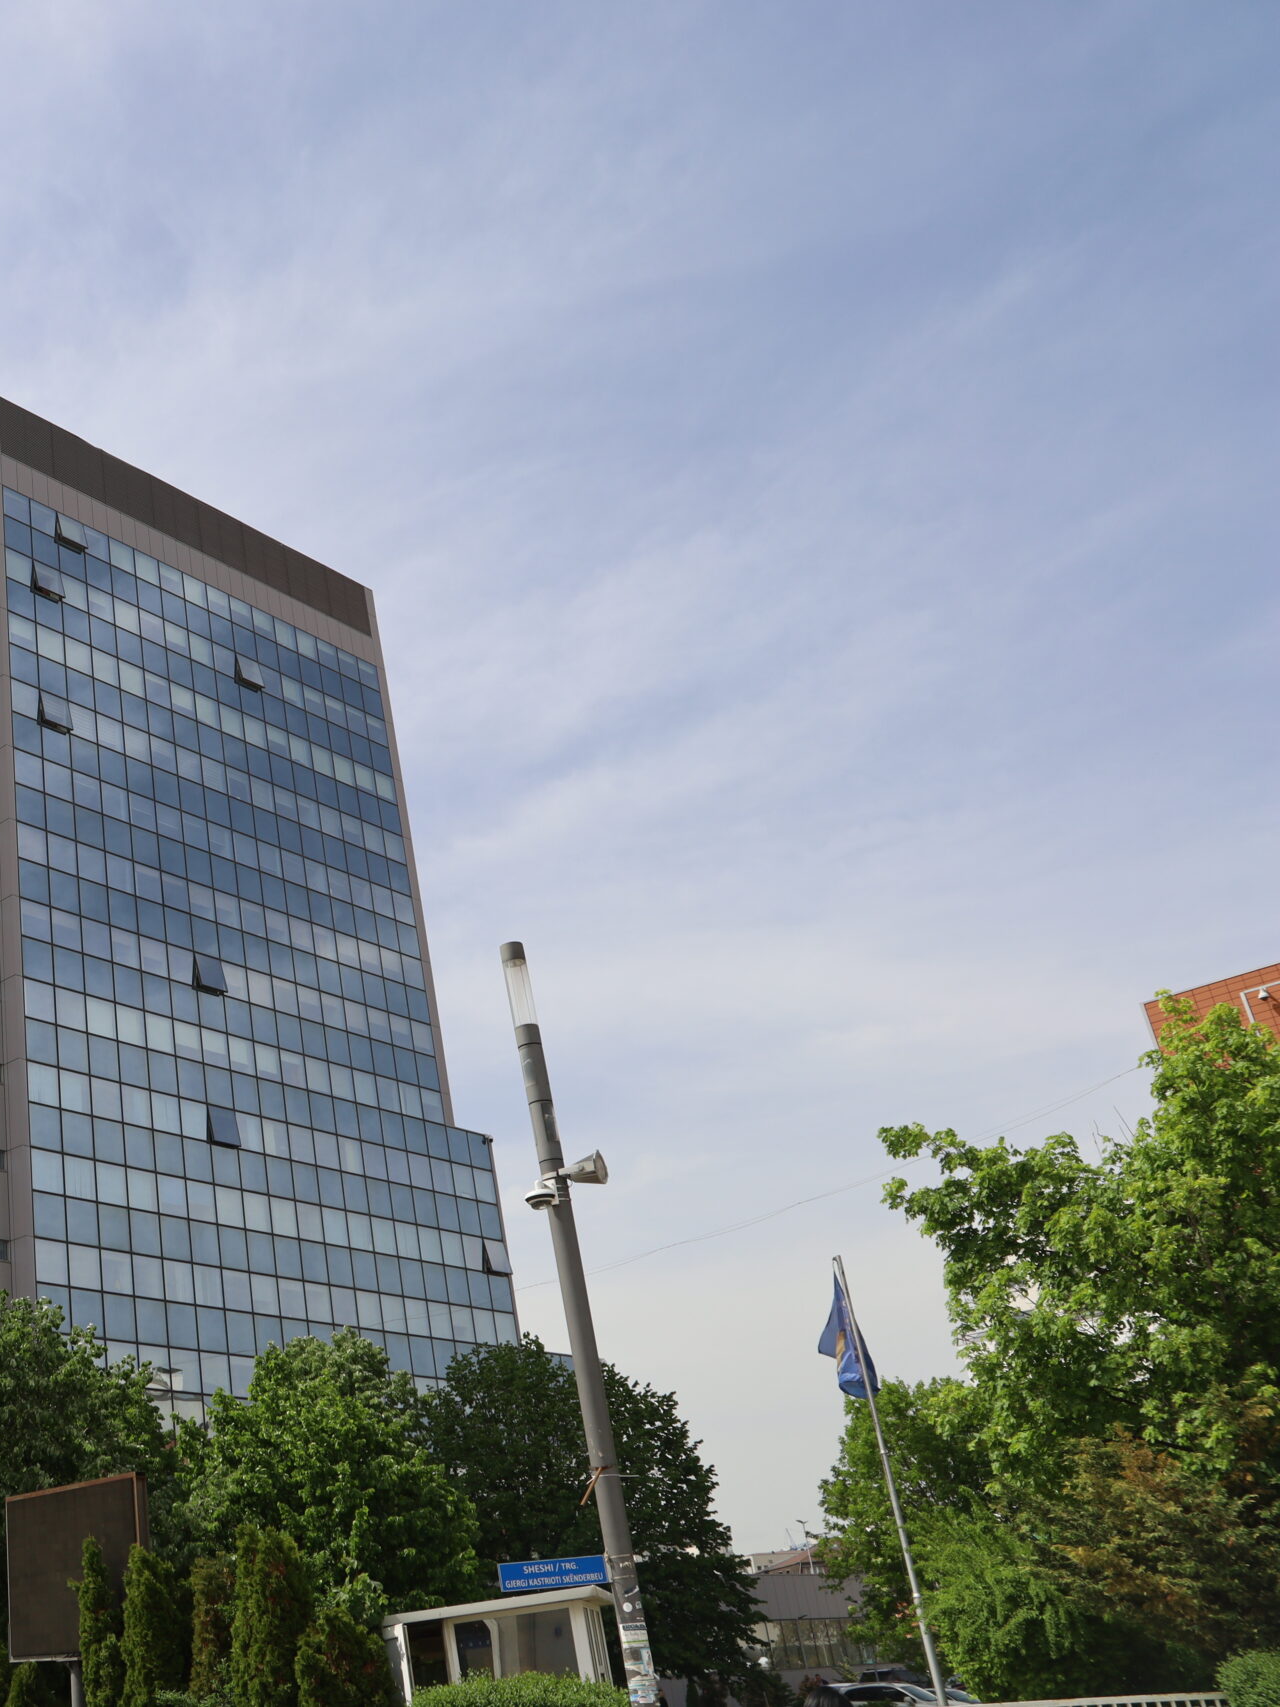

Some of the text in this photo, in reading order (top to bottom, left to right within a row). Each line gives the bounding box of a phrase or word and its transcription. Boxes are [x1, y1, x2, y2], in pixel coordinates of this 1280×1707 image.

[523, 1563, 554, 1574] SHESHI
[561, 1562, 579, 1570] TRG.
[529, 1576, 562, 1587] KASTRIOTI
